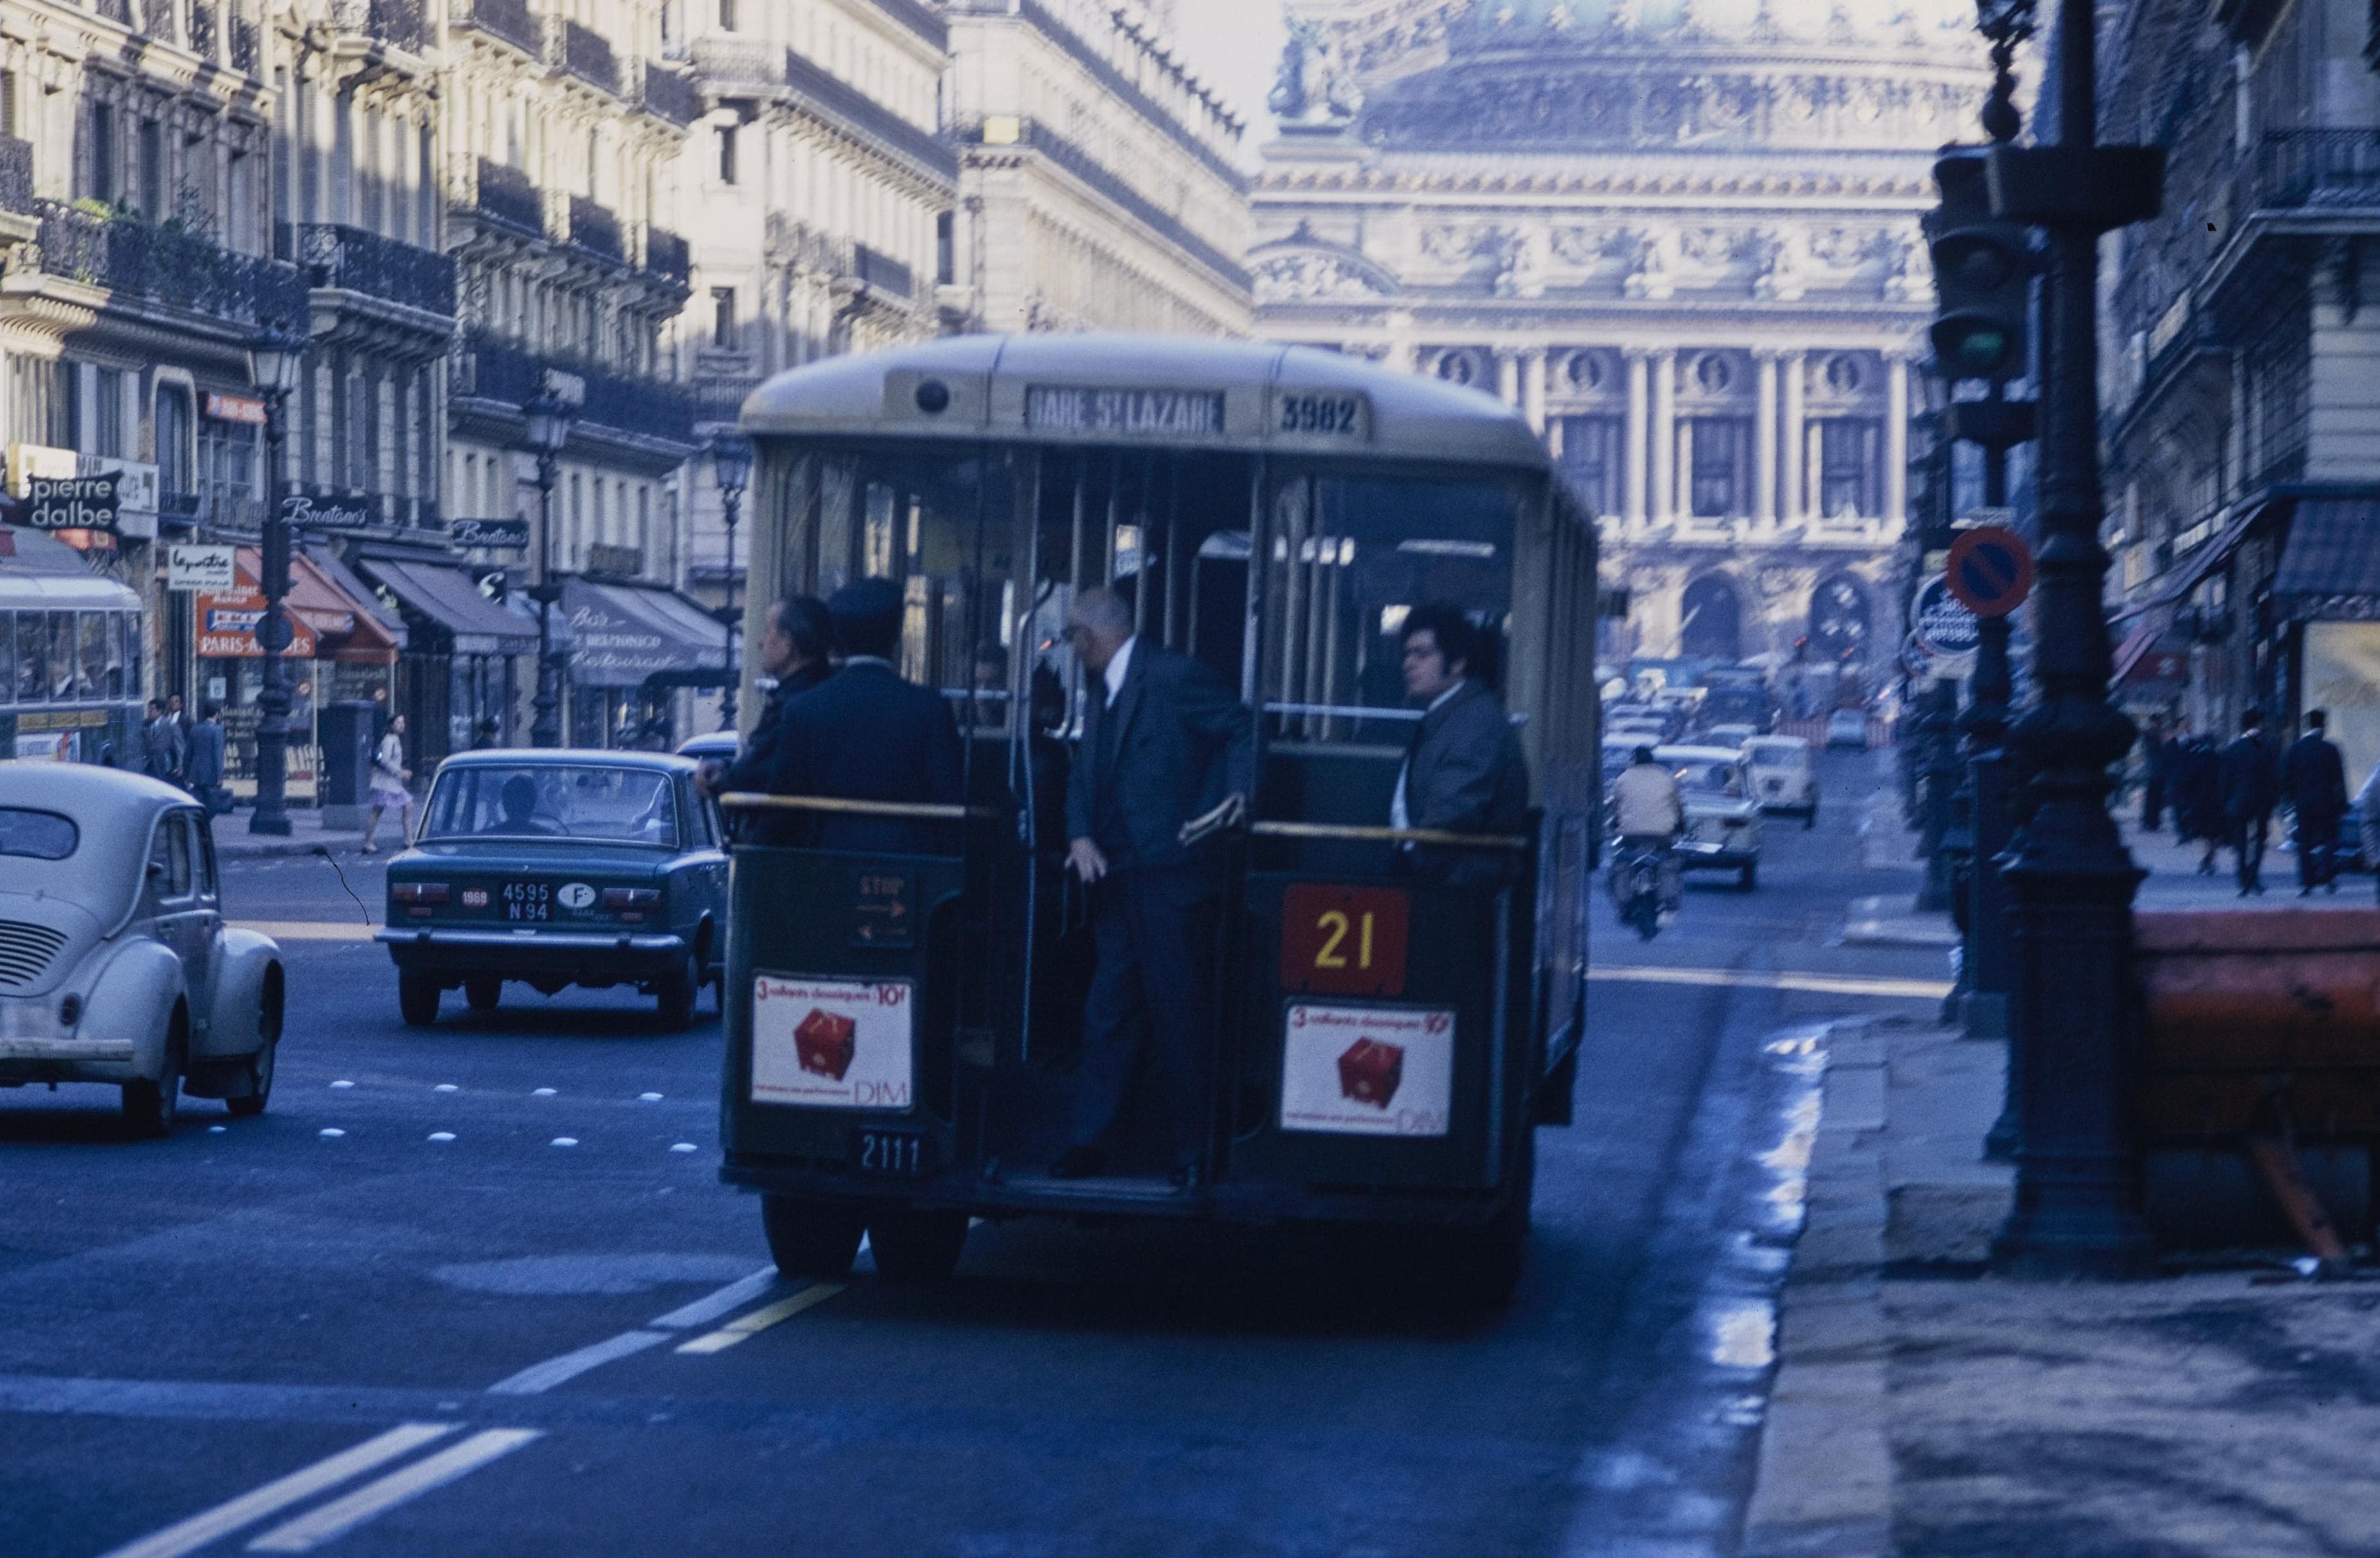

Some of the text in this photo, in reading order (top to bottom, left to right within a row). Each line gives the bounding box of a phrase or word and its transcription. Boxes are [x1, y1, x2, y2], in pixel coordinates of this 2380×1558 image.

[34, 480, 113, 506] pierre
[32, 500, 114, 526] dalbe
[462, 890, 488, 904] 1969
[503, 883, 549, 901] 4595
[573, 886, 585, 904] F
[526, 903, 547, 919] 94
[1314, 910, 1374, 969] 21
[758, 980, 767, 1000] 3
[855, 1081, 908, 1106] DIM
